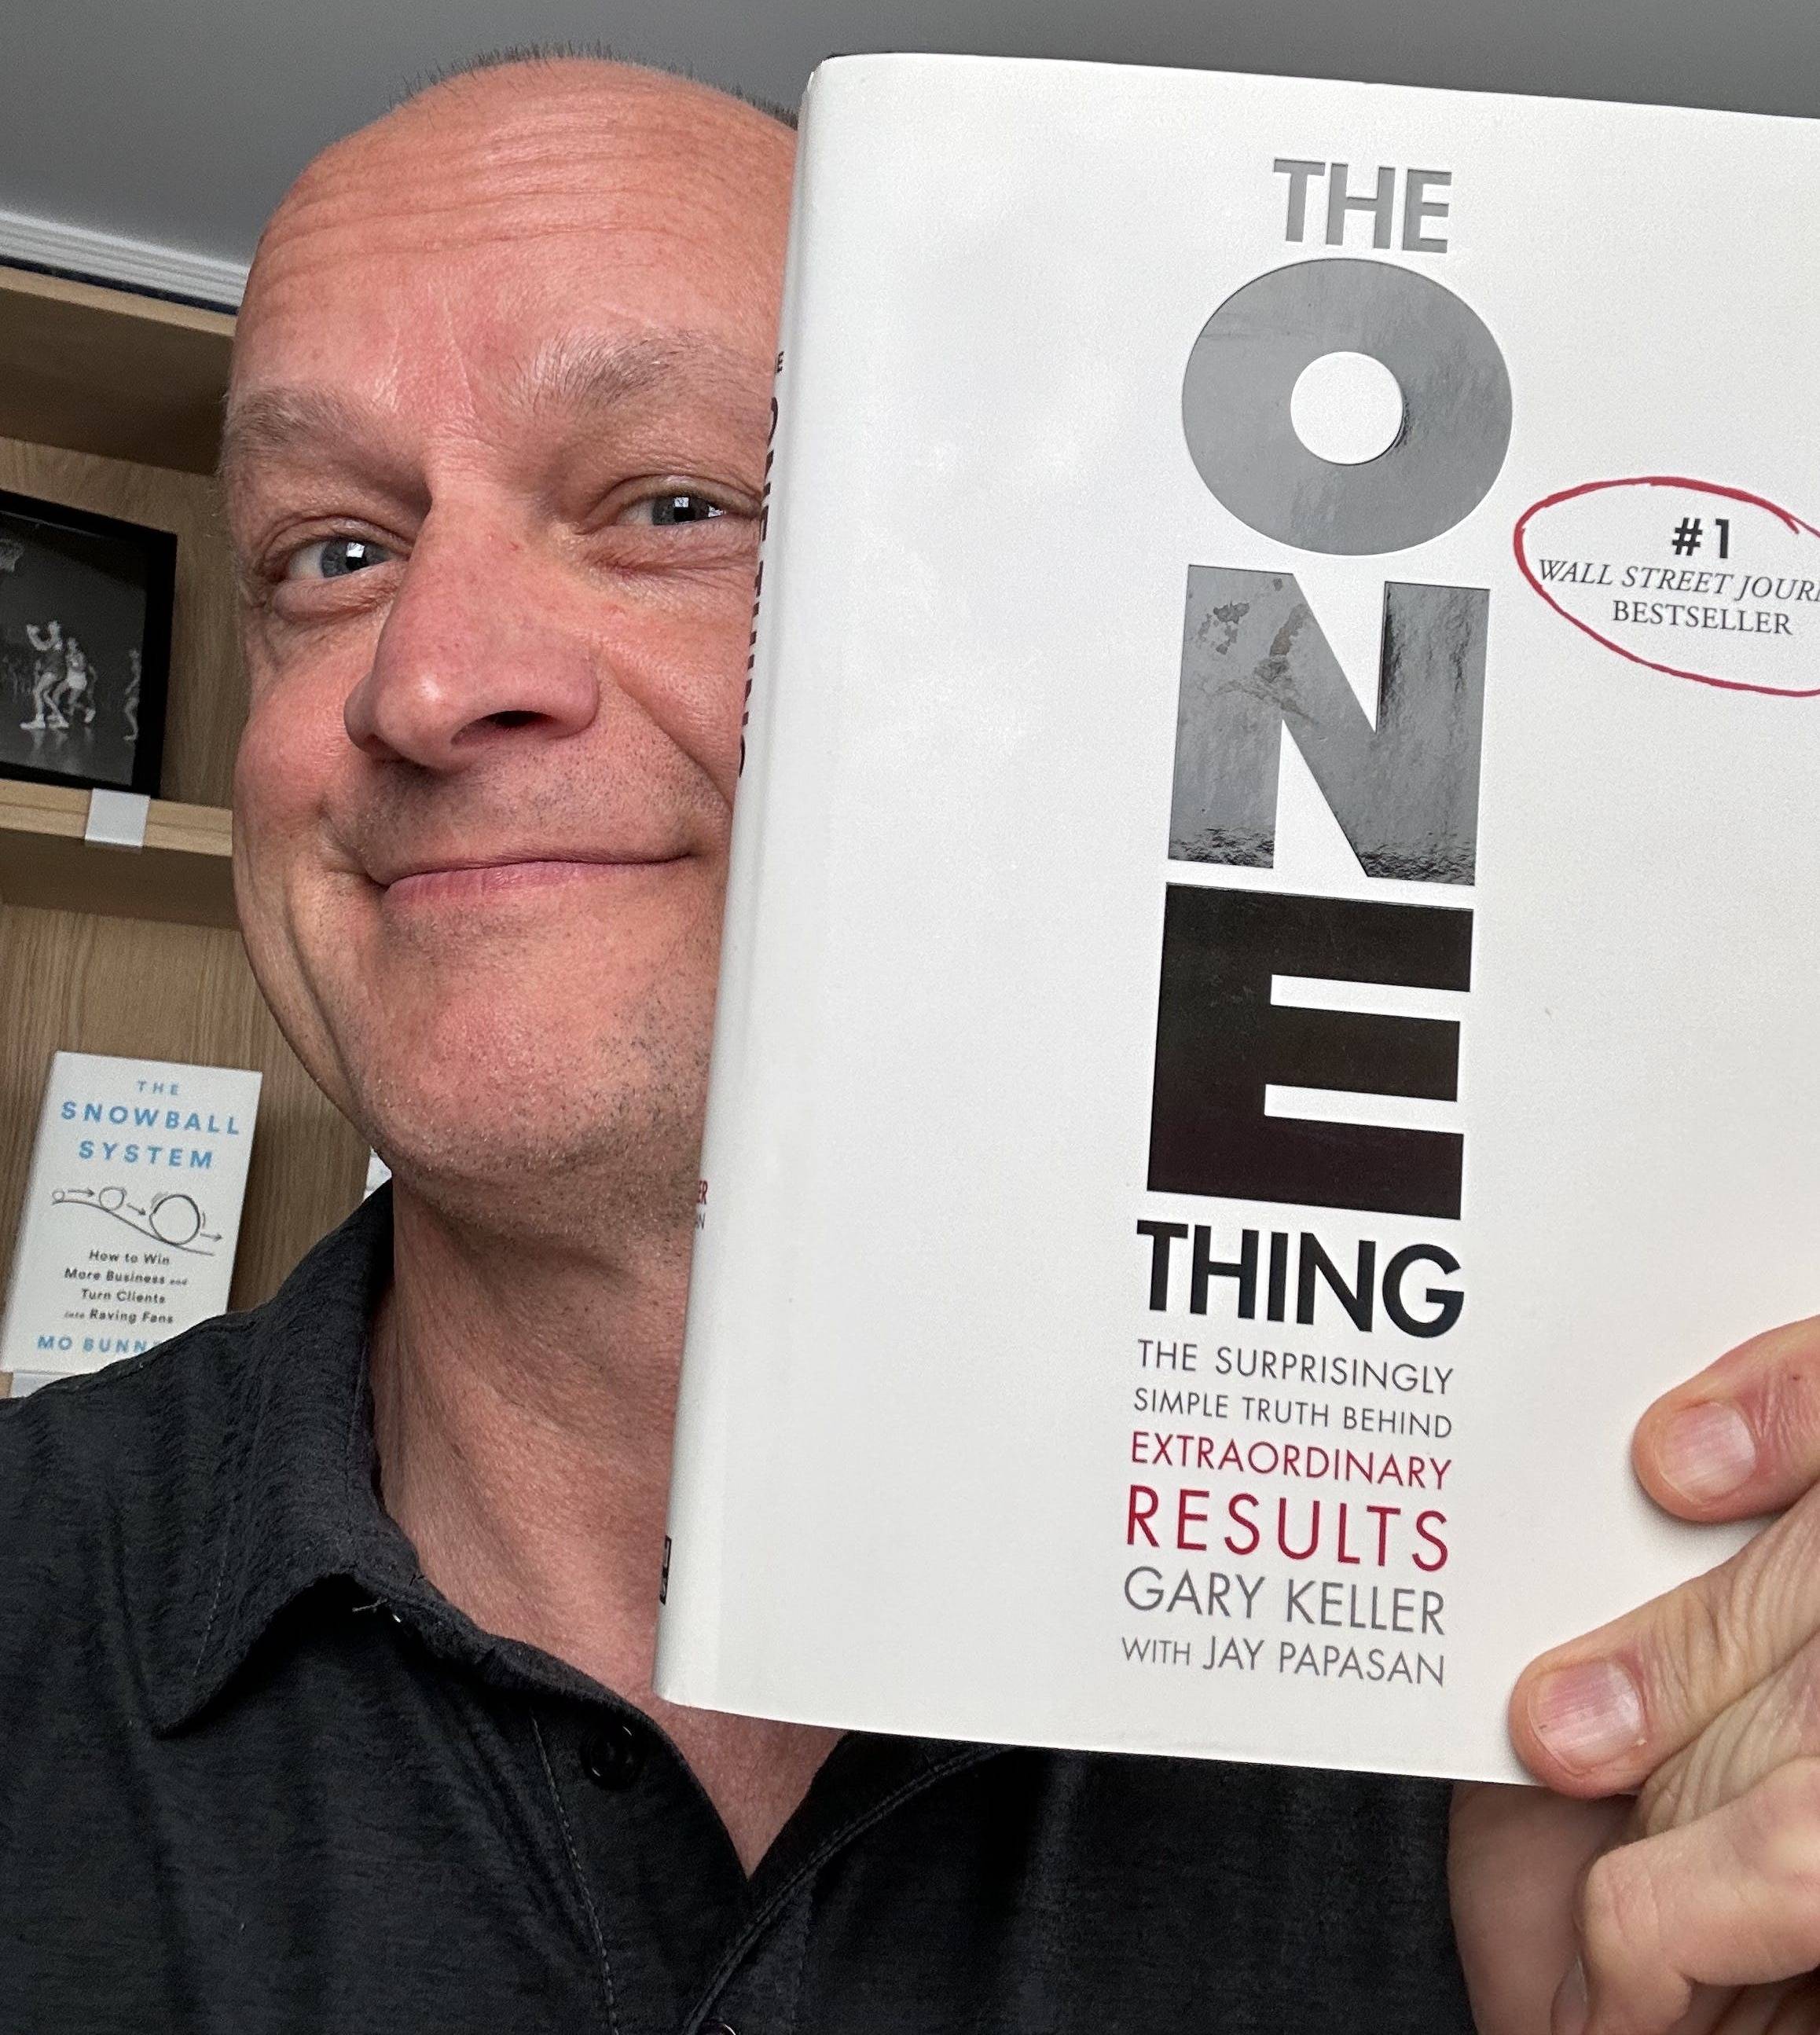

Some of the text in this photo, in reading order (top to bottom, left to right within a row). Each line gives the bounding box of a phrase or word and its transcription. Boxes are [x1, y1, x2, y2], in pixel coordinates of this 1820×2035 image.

[1274, 157, 1452, 253] THE
[1671, 516, 1730, 559] #1
[1539, 559, 1613, 585] WALL
[1621, 566, 1734, 595] STREET
[1613, 600, 1792, 636] BESTSELLER
[1147, 258, 1514, 1219] ONE
[138, 1080, 179, 1095] THE
[61, 1101, 240, 1135] SNOWBALL
[79, 1140, 213, 1169] SYSTEM
[64, 1267, 101, 1281] More
[106, 1270, 165, 1285] Business
[89, 1249, 170, 1265] How to Win
[81, 1288, 166, 1304] Turn Clients
[1136, 1219, 1465, 1339] THING
[90, 1307, 137, 1324] Raving
[141, 1311, 174, 1324] Fans
[38, 1336, 163, 1353] MO BUNN
[1137, 1338, 1455, 1395] THE SURPRISINGLY
[1133, 1388, 1452, 1439] SIMPLE TRUTH BEHIND
[1131, 1431, 1452, 1490] EXTRAORDINARY
[1126, 1484, 1449, 1572] RESULTS
[1124, 1566, 1445, 1636] GARY KELLER
[1121, 1636, 1445, 1688] WITH JAY PAPASAN
